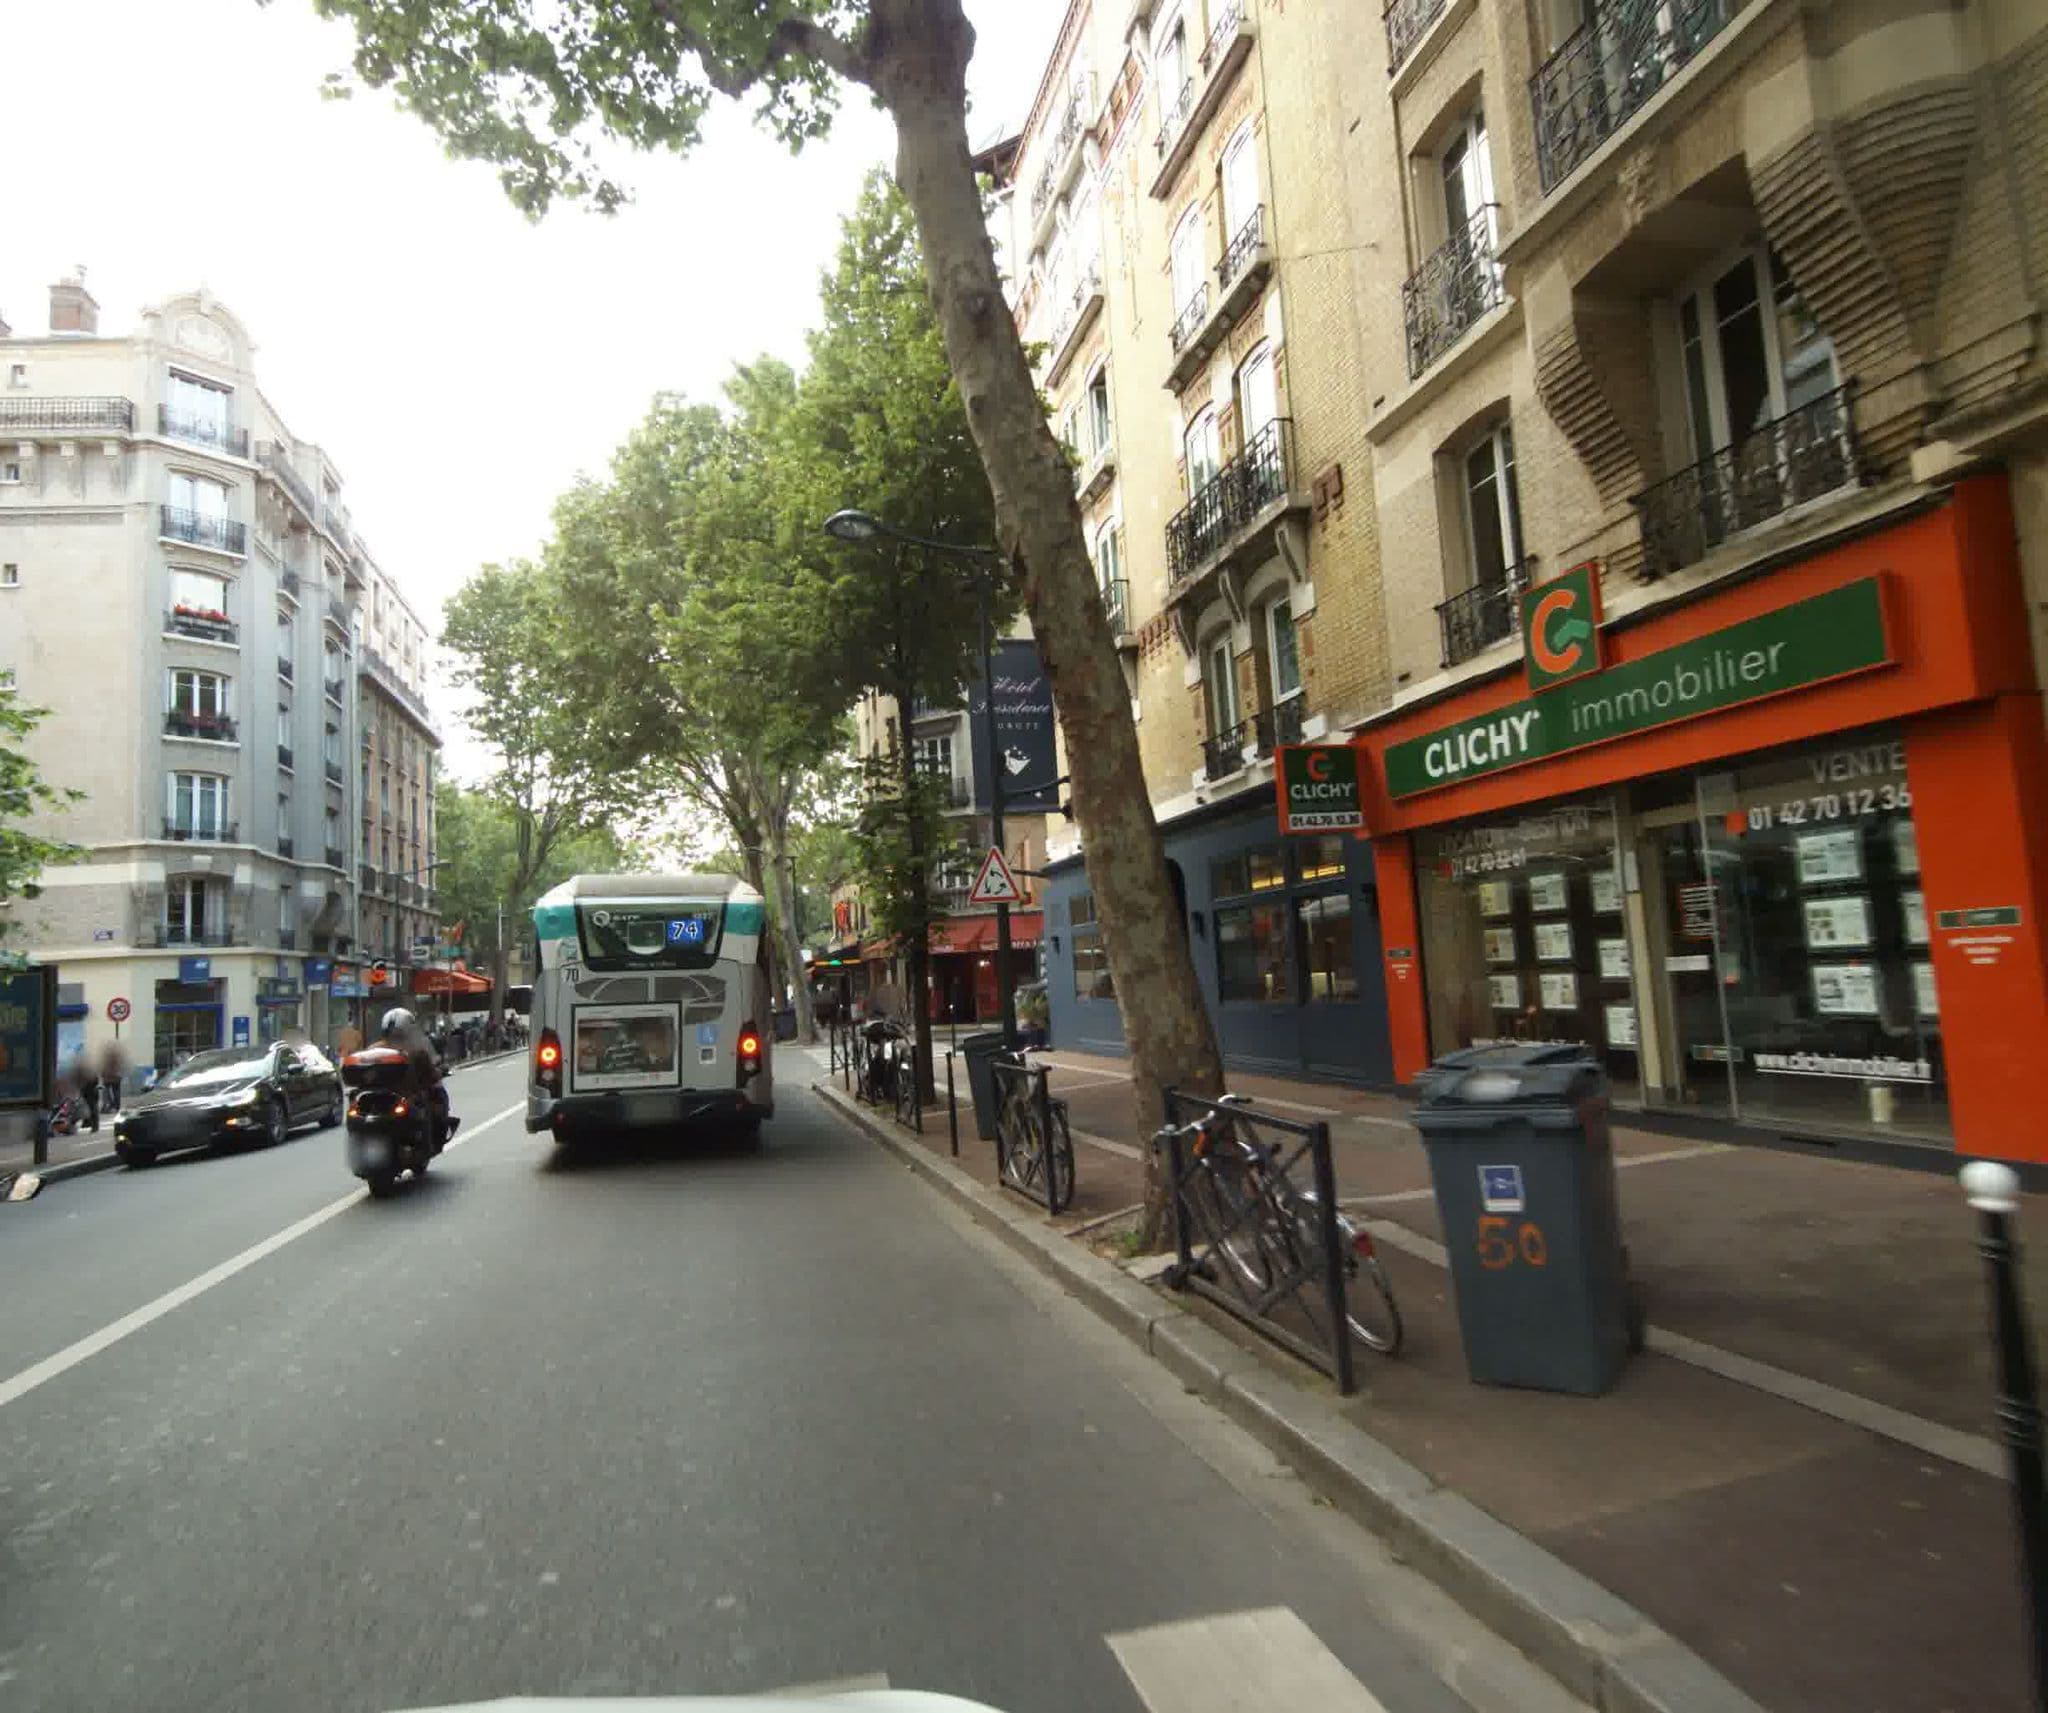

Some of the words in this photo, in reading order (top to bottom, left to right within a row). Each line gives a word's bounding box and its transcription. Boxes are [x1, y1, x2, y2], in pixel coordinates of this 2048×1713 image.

[1424, 710, 1532, 778] CLICHY
[1572, 641, 1786, 733] immobilier
[1812, 741, 1908, 784] VENTE
[1290, 782, 1354, 799] CLICHY
[1749, 806, 1773, 831] 01
[1780, 799, 1808, 825] 42
[1811, 793, 1841, 821] 70
[1846, 788, 1877, 816] 12
[1879, 781, 1914, 811] 36
[671, 920, 699, 940] 74
[112, 1002, 127, 1016] 30
